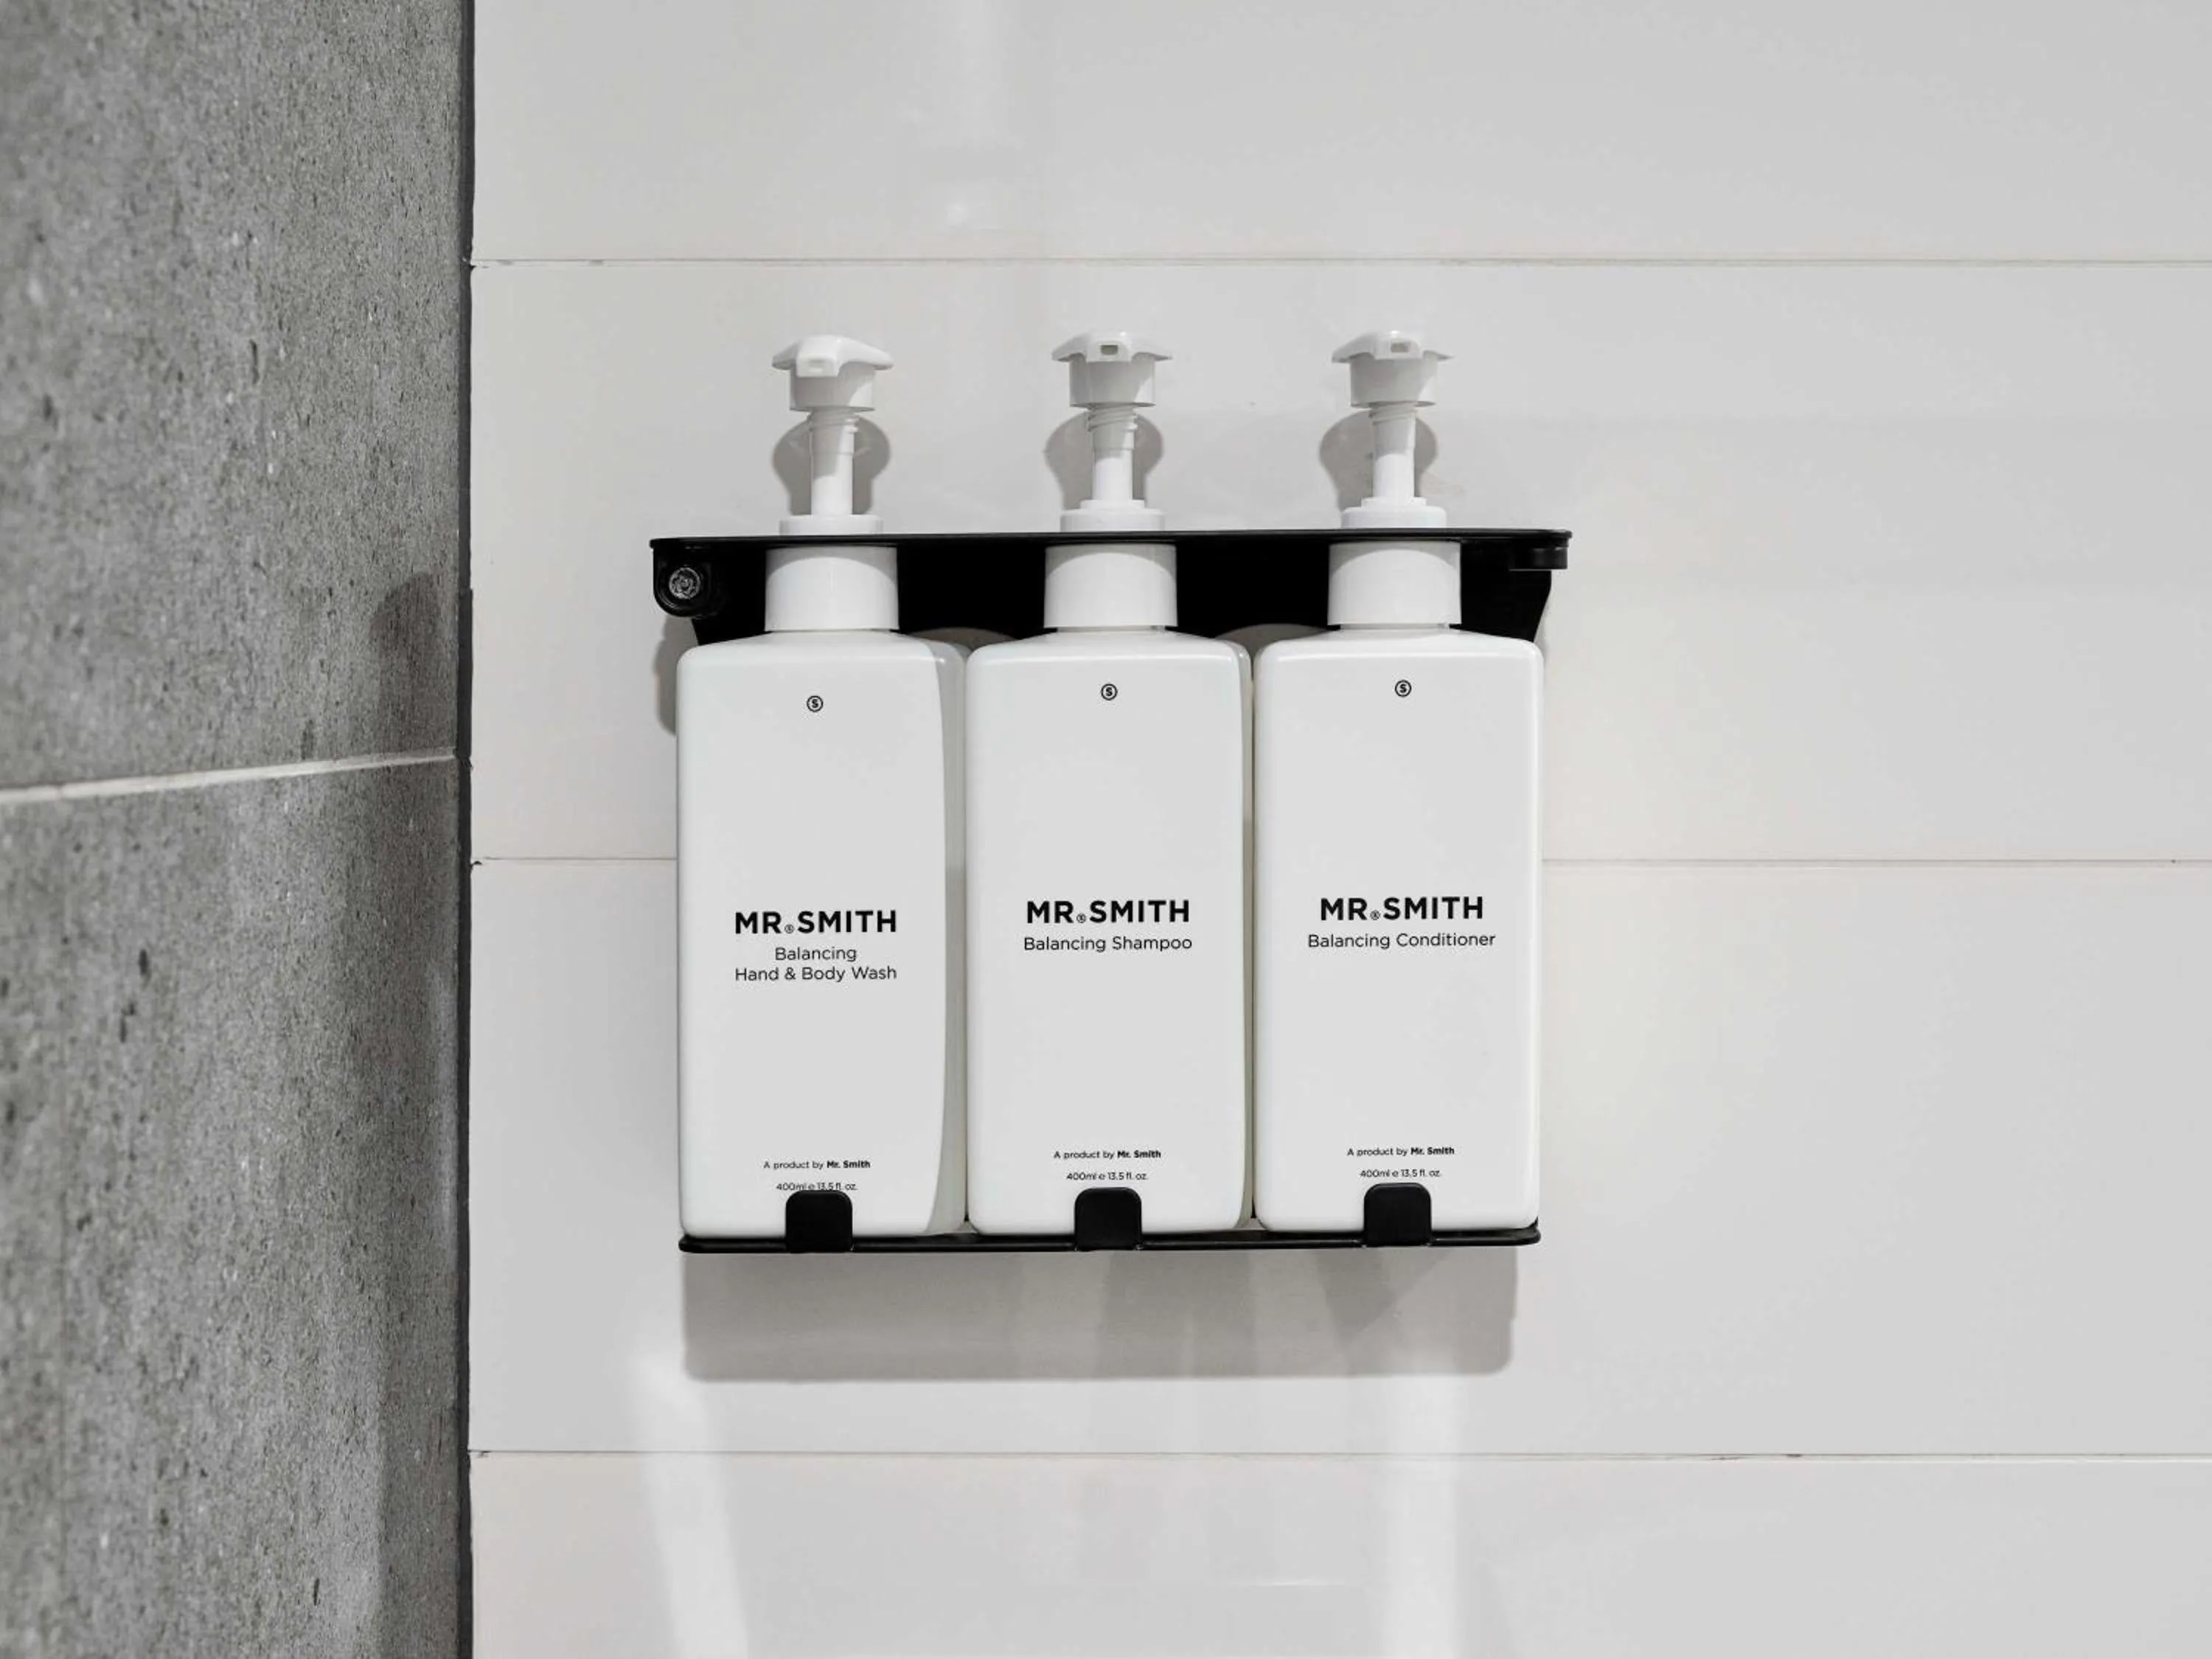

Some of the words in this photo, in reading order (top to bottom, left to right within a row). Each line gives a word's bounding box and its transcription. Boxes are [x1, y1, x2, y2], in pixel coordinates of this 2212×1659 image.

[1024, 936, 1106, 953] Balancing
[1112, 936, 1192, 952] Shampoo
[1308, 933, 1390, 950] Balancing
[1397, 933, 1495, 947] Conditioner
[776, 947, 857, 962] Balancing
[736, 967, 779, 981] Hand
[785, 967, 796, 981] &
[802, 966, 846, 982] Body
[851, 965, 897, 979] Wash
[1063, 1151, 1100, 1159] product
[1103, 1151, 1114, 1159] by
[1117, 1150, 1131, 1158] Mr.
[1134, 1150, 1161, 1158] Smith
[1357, 1148, 1394, 1156] product
[1397, 1148, 1407, 1156] by
[1427, 1147, 1454, 1155] Smith
[773, 1161, 810, 1169] product
[813, 1161, 824, 1170] by
[844, 1160, 870, 1168] Smith
[1066, 1172, 1096, 1180] 400ml
[1360, 1169, 1390, 1178] 400ml
[1401, 1169, 1417, 1177] 13.5
